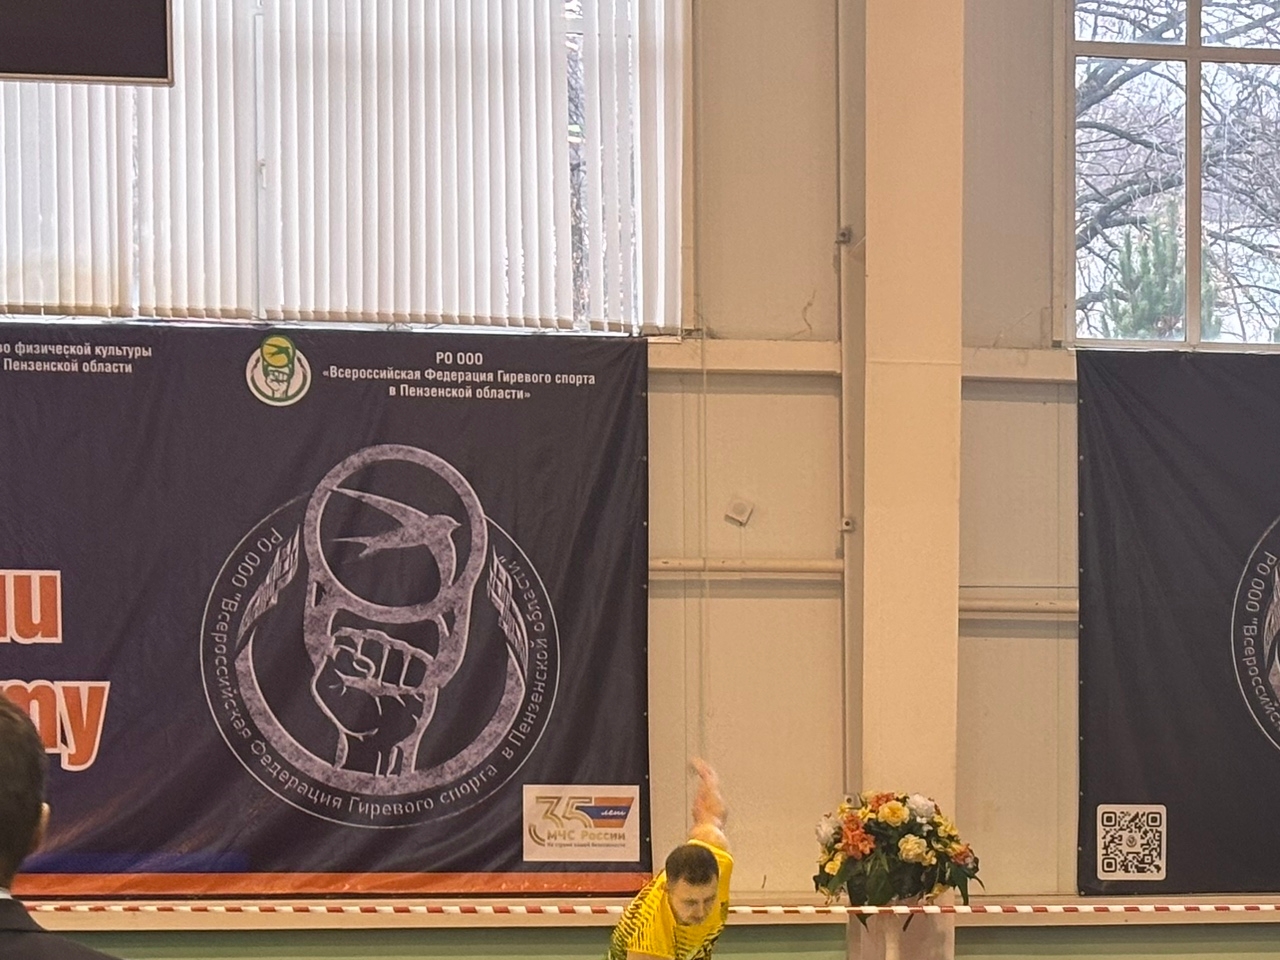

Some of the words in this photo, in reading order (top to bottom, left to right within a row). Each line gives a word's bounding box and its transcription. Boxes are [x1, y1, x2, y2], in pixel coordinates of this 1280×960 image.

[14, 341, 92, 356] физической
[94, 345, 152, 359] культуры
[3, 357, 79, 372] Пензенской
[82, 360, 133, 373] области
[436, 352, 453, 365] РО
[456, 352, 483, 366] ООО
[322, 366, 421, 381] «Всероссийская
[424, 368, 494, 384] Федерация
[497, 370, 552, 386] Гиревого
[555, 373, 596, 387] спорта
[389, 386, 396, 396] в
[400, 384, 473, 398] Пензенской
[476, 386, 531, 400] области»
[250, 739, 343, 810] Федерация
[348, 796, 434, 820] Гиревого
[440, 763, 499, 804] спорта
[532, 796, 593, 832] 35
[547, 830, 575, 840] МЧС
[580, 830, 626, 840] России
